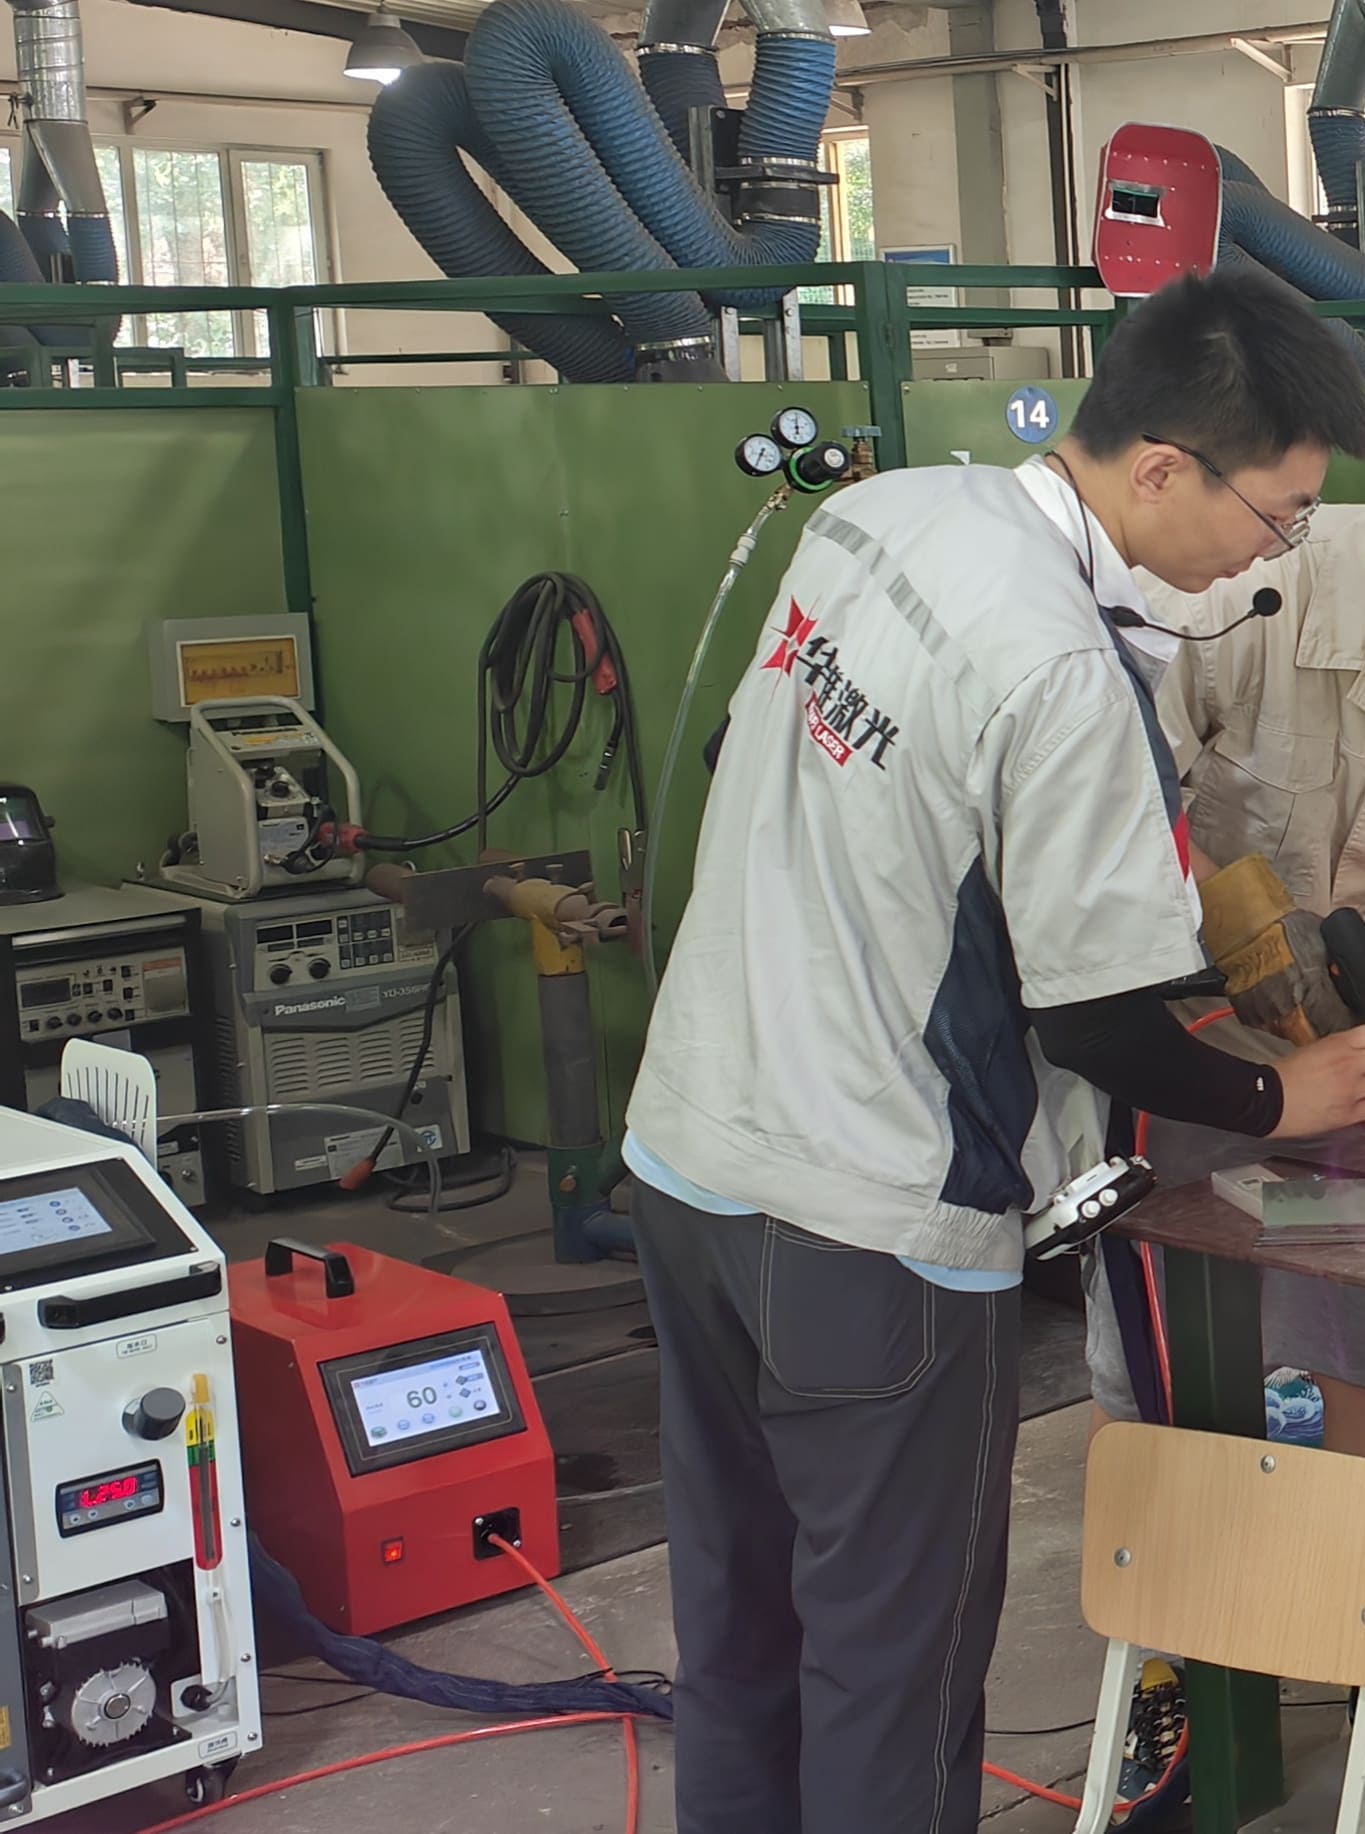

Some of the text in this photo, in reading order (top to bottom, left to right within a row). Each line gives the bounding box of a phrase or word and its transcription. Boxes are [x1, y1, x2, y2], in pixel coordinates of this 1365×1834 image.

[1010, 400, 1050, 428] 14
[814, 725, 846, 760] LASER
[274, 995, 346, 1016] Panasonic
[406, 1386, 438, 1409] 60
